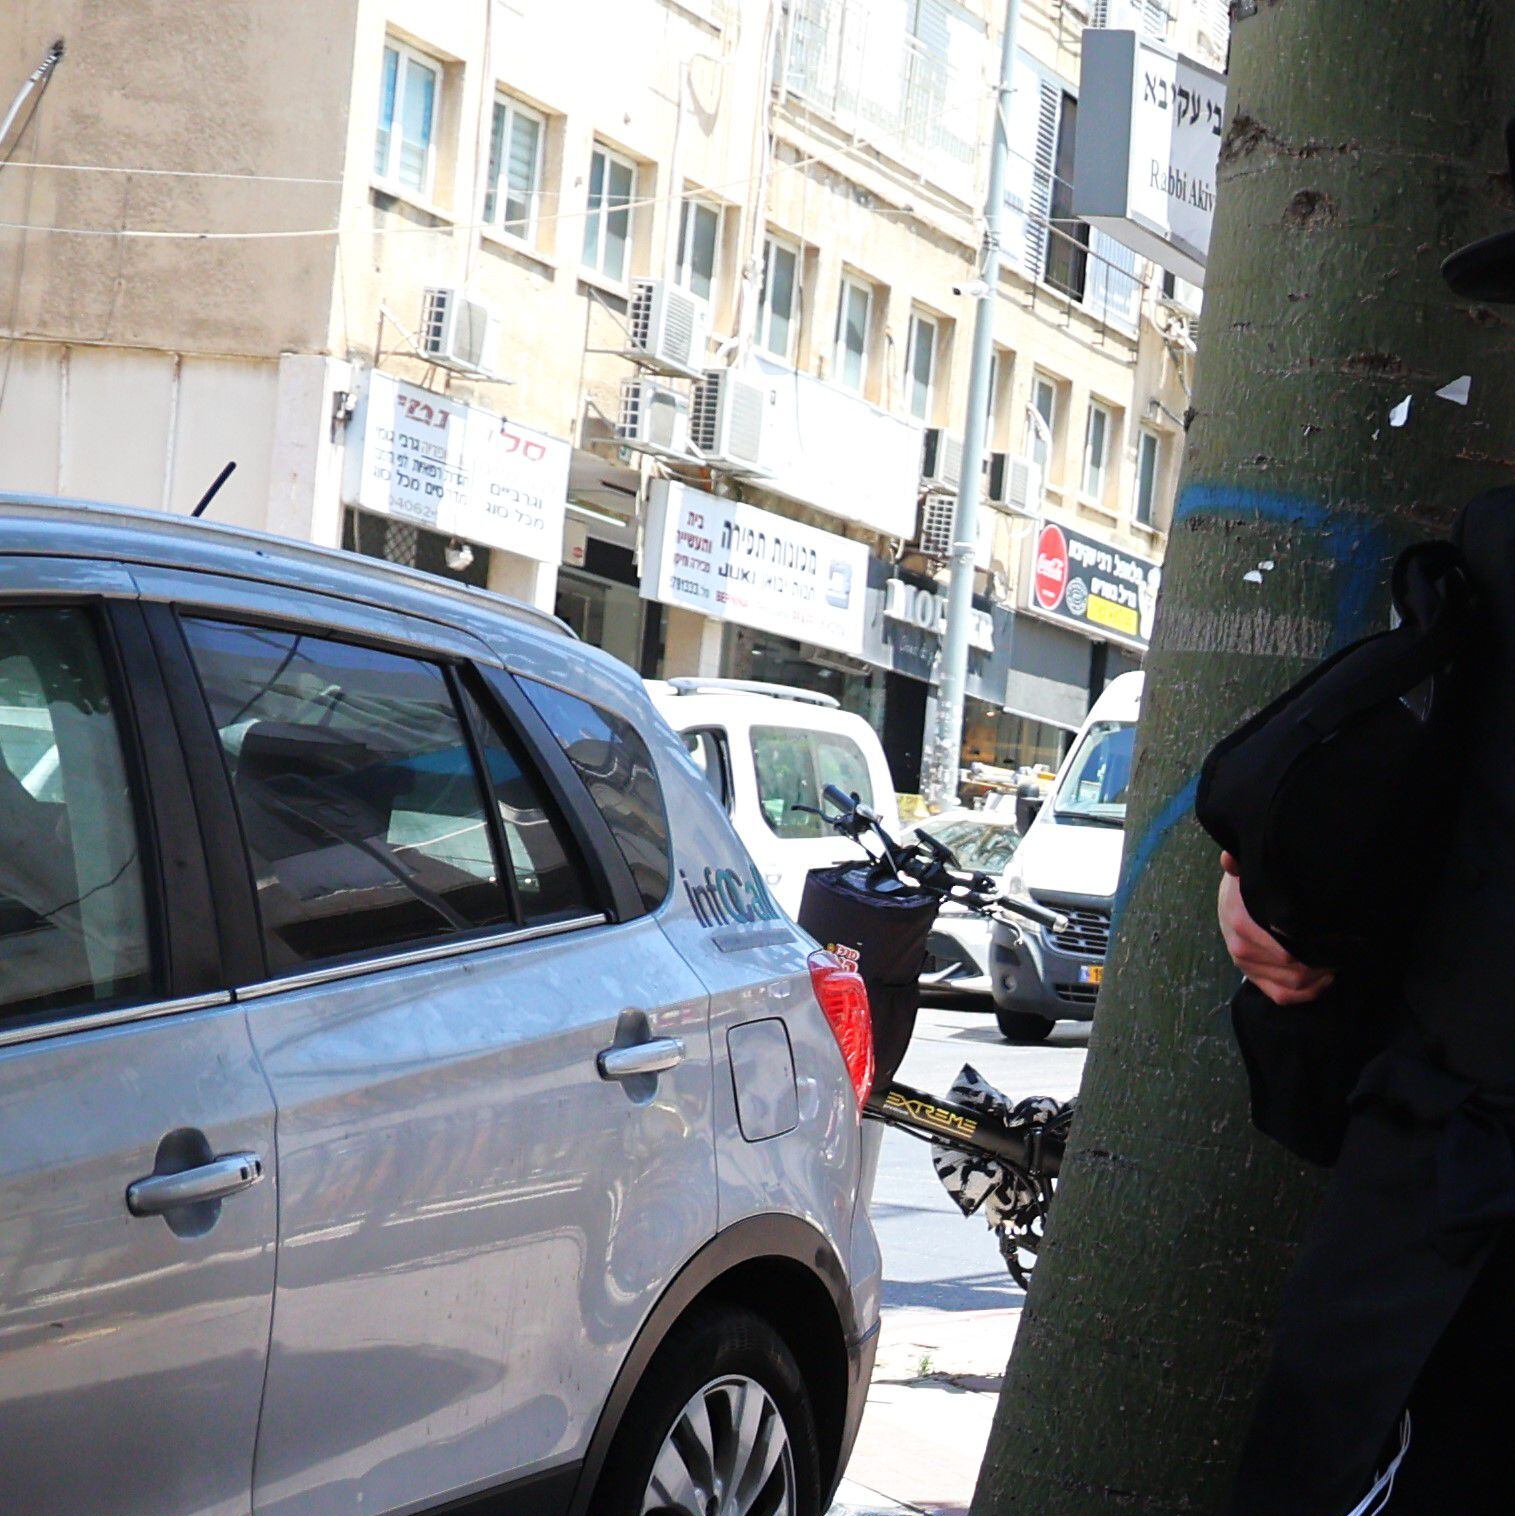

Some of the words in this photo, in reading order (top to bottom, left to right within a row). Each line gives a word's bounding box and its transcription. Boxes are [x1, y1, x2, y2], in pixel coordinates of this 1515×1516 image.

[1144, 71, 1201, 127] עקיבא
[1206, 98, 1222, 136] בי
[1150, 158, 1187, 202] Rabbi
[1188, 178, 1216, 212] Akiv
[720, 519, 766, 559] תפירה
[771, 536, 817, 576] מכונות
[883, 1090, 978, 1138] EXTREME
